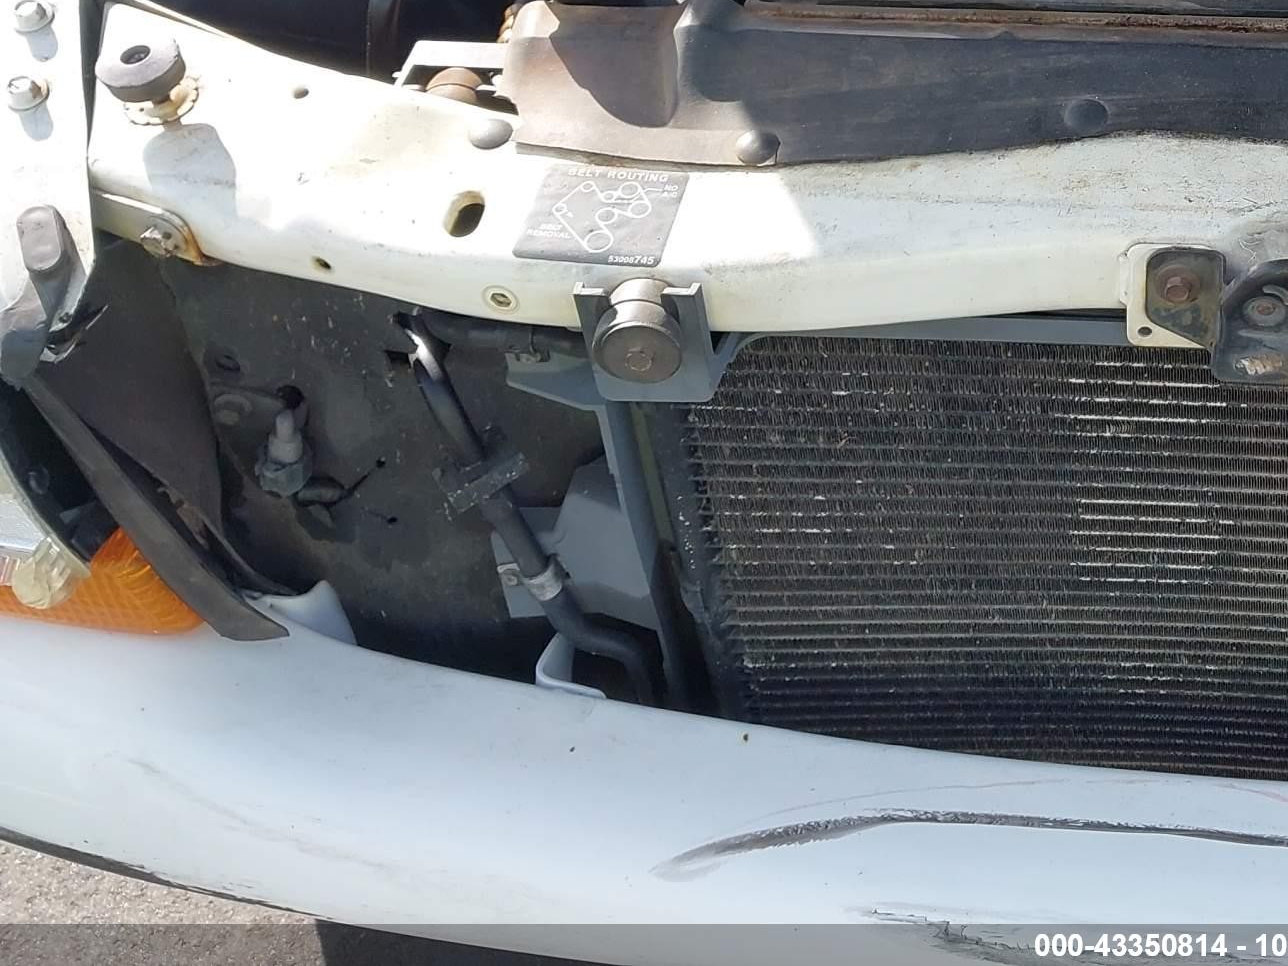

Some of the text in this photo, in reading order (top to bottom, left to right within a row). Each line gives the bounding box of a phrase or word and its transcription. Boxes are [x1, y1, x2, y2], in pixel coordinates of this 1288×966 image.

[567, 168, 669, 183] BELT ROUTING
[607, 255, 656, 265] 53008745
